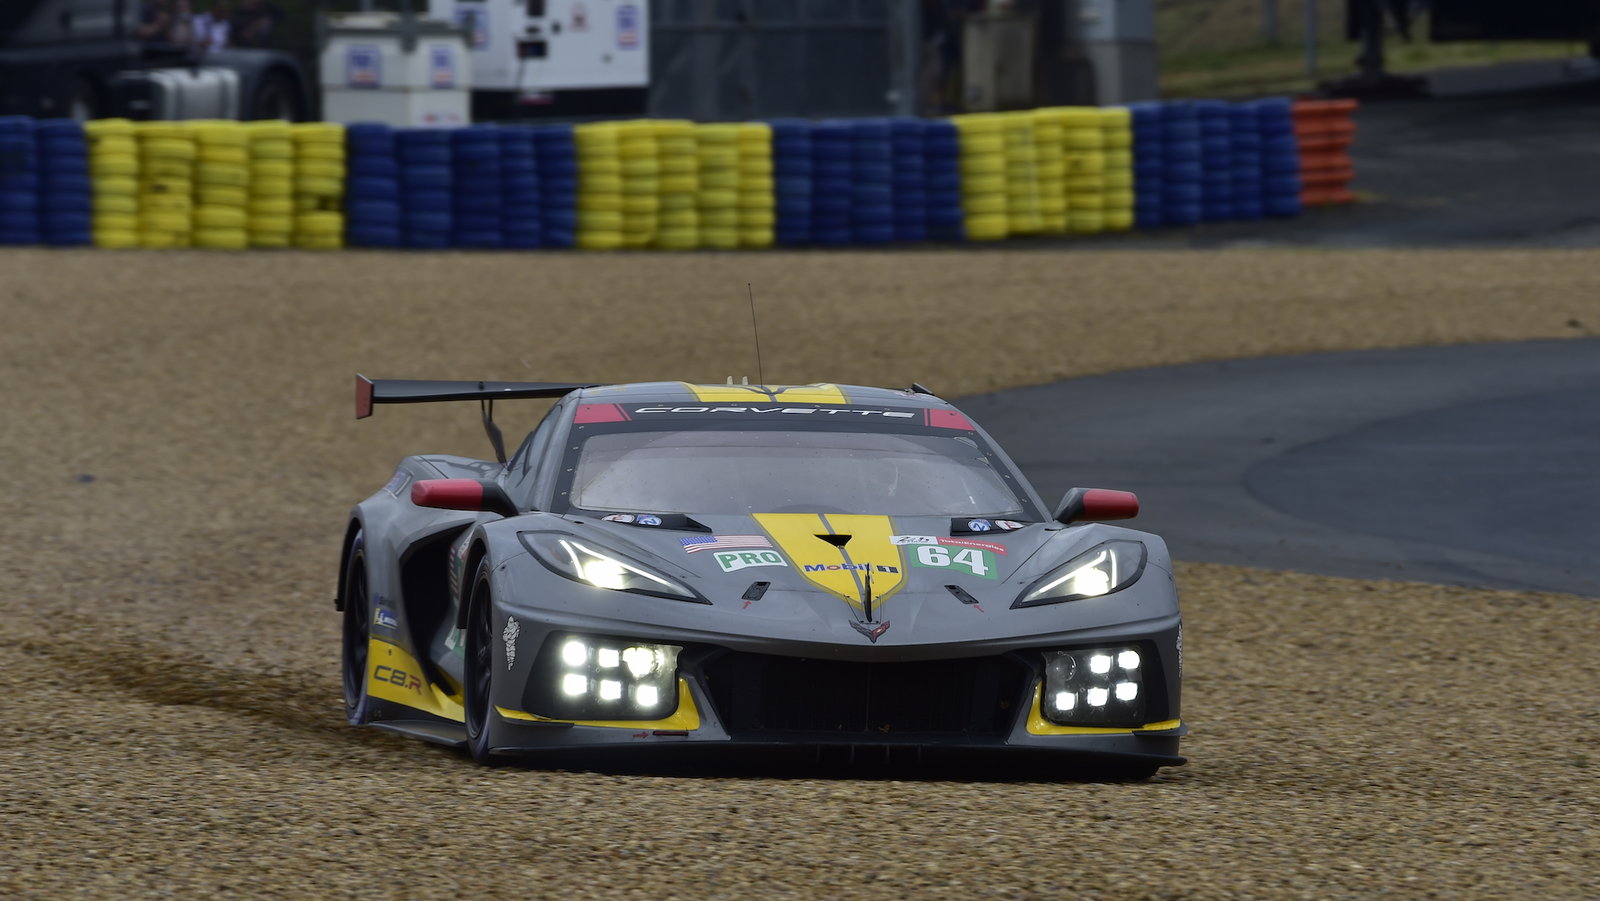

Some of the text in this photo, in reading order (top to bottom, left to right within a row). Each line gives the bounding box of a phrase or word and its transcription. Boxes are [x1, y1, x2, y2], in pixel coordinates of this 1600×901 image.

[635, 407, 915, 418] CORVETTE
[718, 551, 782, 569] PRO
[804, 563, 871, 572] Mobil
[917, 545, 988, 576] 64
[374, 665, 422, 695] C8.R
